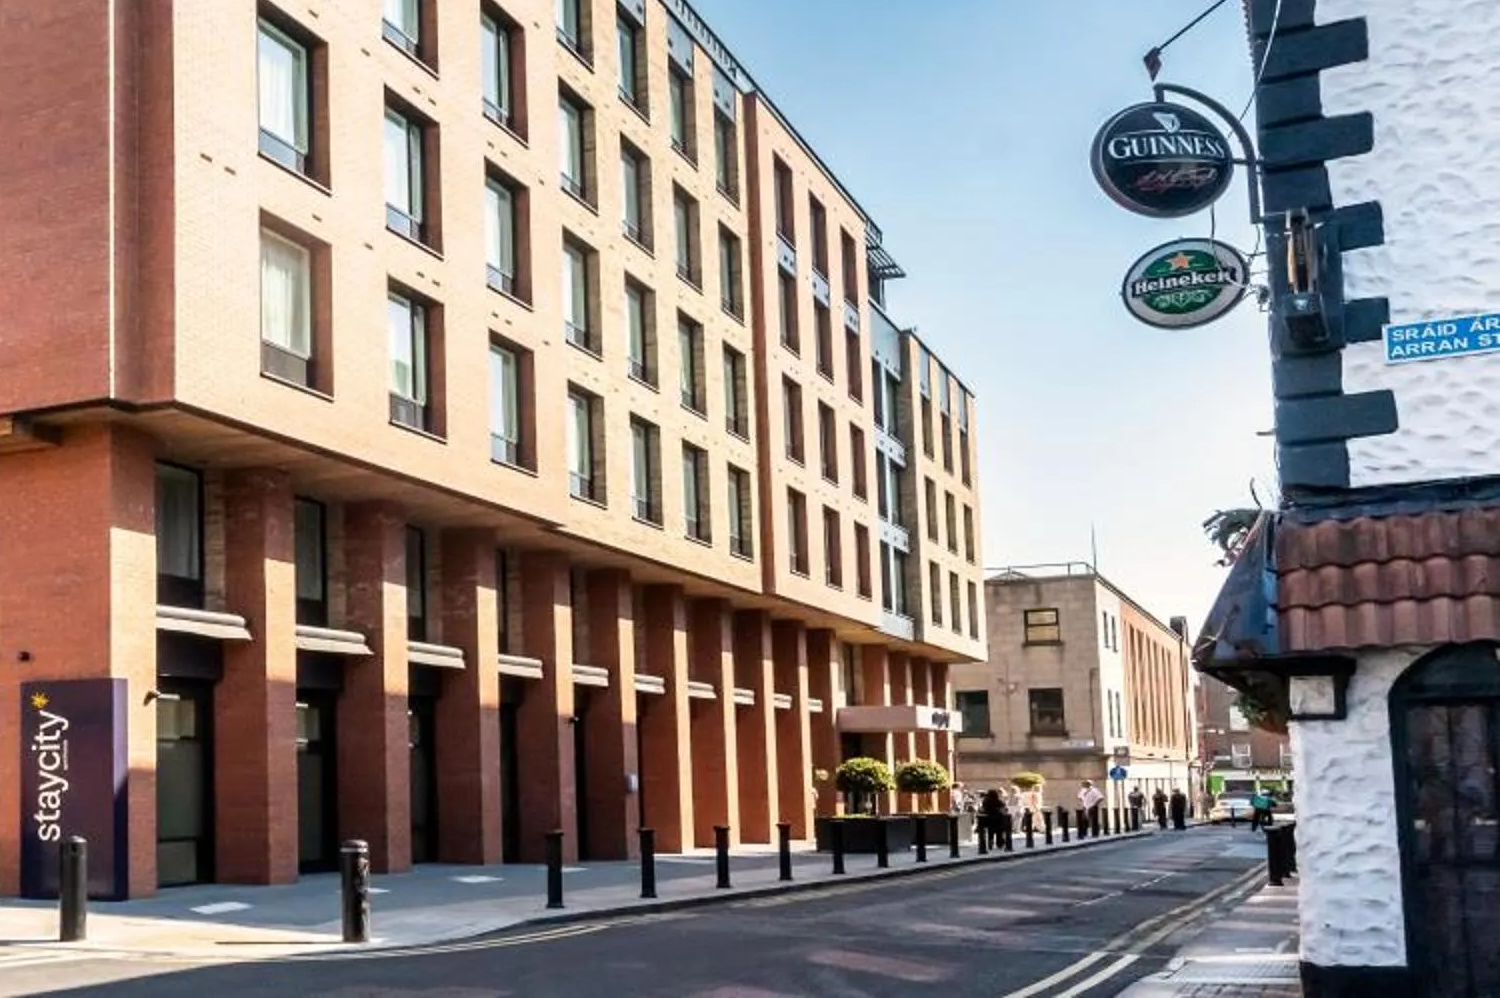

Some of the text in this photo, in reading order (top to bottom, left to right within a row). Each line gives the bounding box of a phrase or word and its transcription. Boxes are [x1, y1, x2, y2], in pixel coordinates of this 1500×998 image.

[1108, 136, 1225, 159] GUINNESS
[1133, 269, 1235, 295] Heineken
[1391, 337, 1468, 357] ARRAN
[31, 709, 69, 842] staycity
